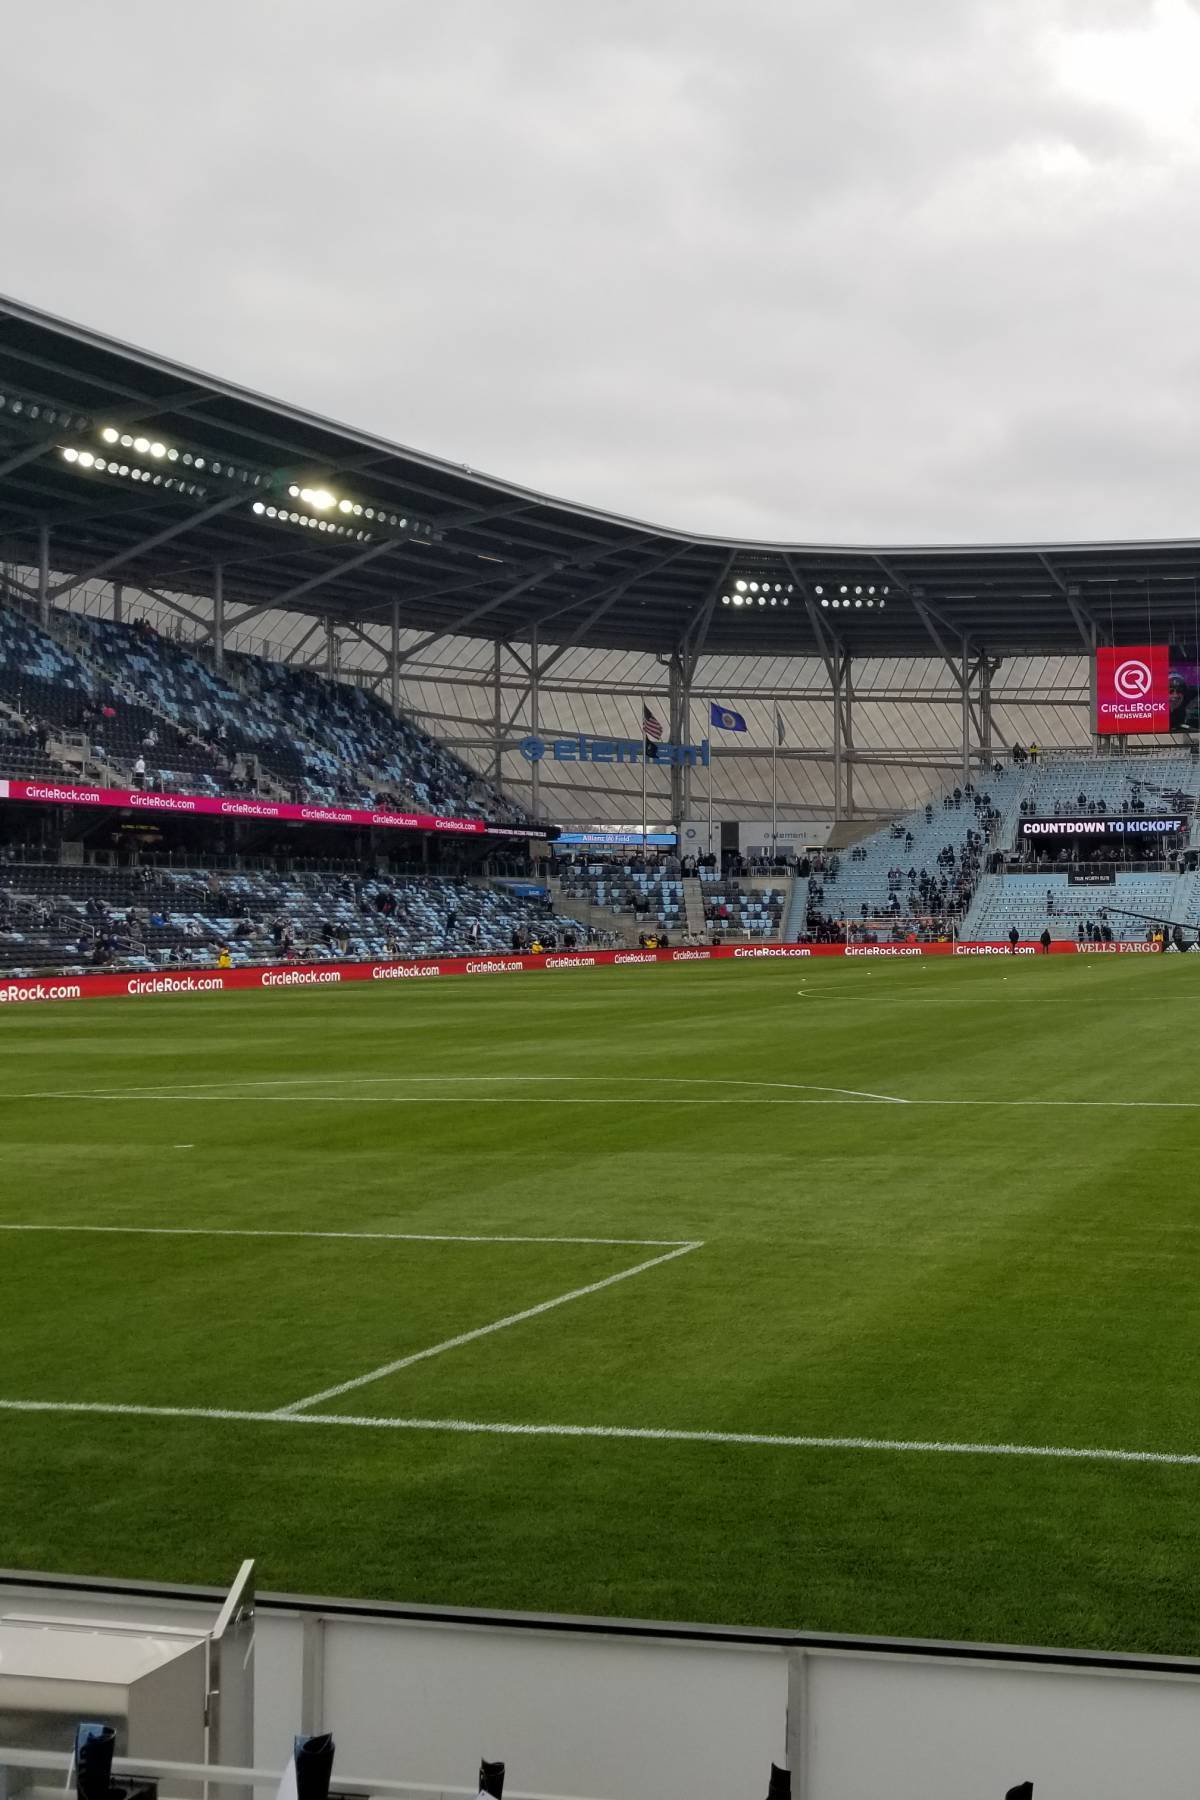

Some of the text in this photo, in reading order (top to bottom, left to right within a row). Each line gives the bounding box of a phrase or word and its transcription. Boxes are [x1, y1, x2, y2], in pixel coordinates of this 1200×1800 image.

[26, 786, 100, 802] CircleRock.com
[130, 795, 195, 810] CircleRock.com
[221, 802, 279, 816] CircleRock.com
[301, 809, 352, 821] CircleRock.com
[372, 815, 418, 827] CircleRock.com
[435, 820, 476, 831] CircleRock.com
[1023, 820, 1181, 834] COUNTDOWN TO KICKOFF
[734, 947, 811, 957] CircleRock.com
[844, 946, 922, 955] CircleRock.com
[956, 945, 1035, 955] CircleRock.com
[1076, 942, 1160, 953] WELLS FARGO
[614, 952, 657, 964] CircleRock.com
[672, 950, 711, 960] CircleRock.com
[466, 960, 523, 973] CircleRock.com
[545, 956, 595, 968] CircleRock.com
[372, 964, 440, 979] CircleRock.com
[261, 970, 341, 986] CircleRock.com
[127, 976, 223, 995] CircleRock.com
